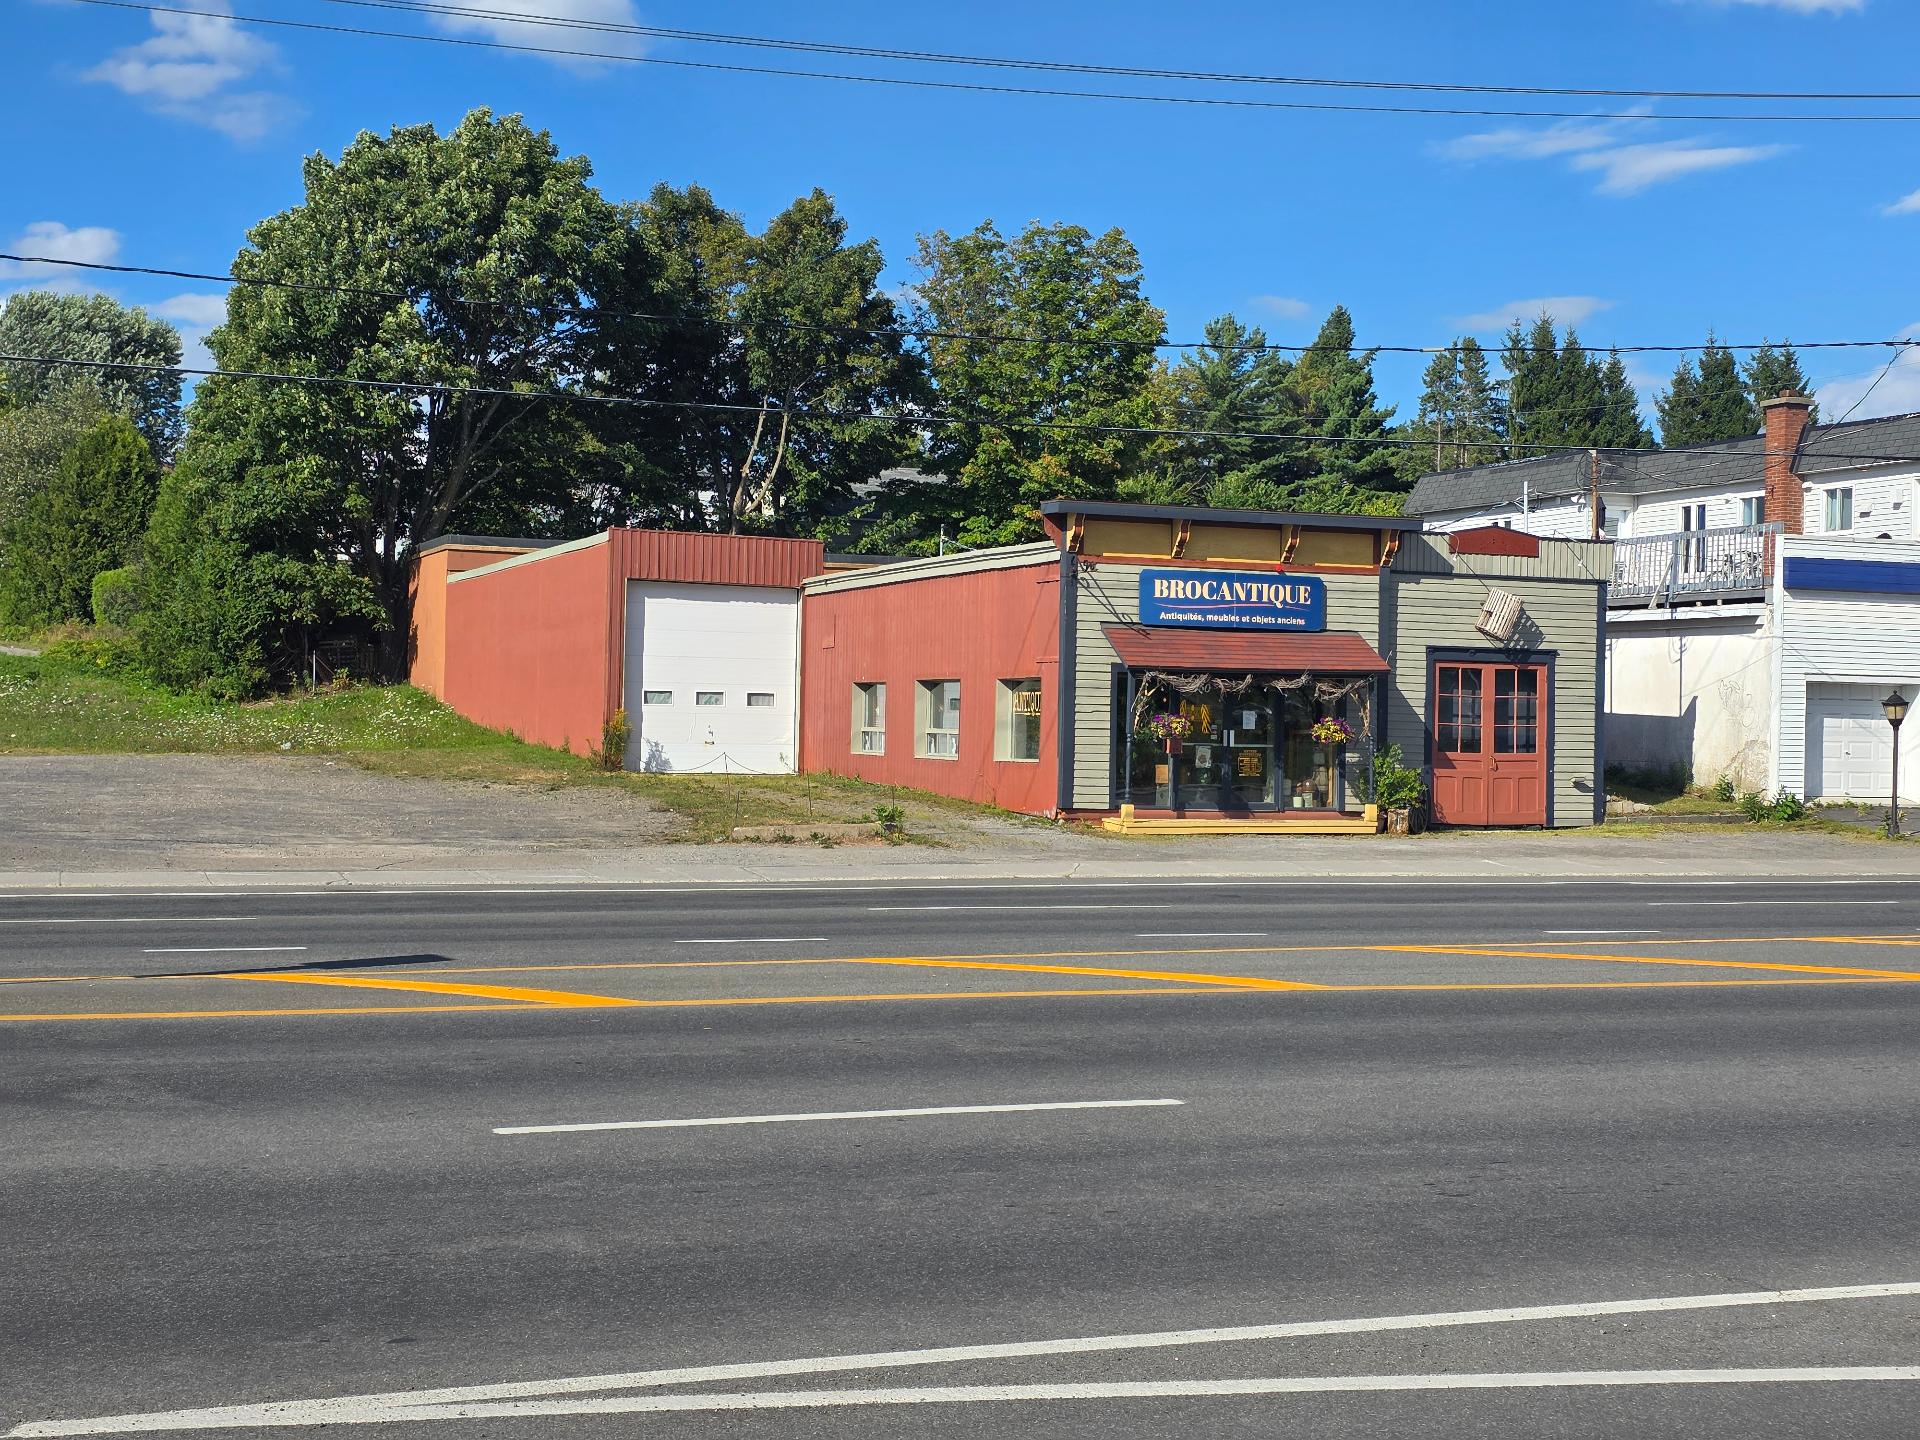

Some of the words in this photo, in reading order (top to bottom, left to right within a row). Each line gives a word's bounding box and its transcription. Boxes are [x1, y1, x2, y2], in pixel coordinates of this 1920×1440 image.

[1153, 578, 1311, 609] BROCANTIQUE
[1159, 611, 1205, 623] Antiquités,
[1206, 613, 1240, 623] meubles
[1241, 615, 1250, 623] et
[1251, 615, 1276, 625] objets
[1276, 616, 1306, 626] anciens
[1013, 691, 1041, 716] ANTIQU
